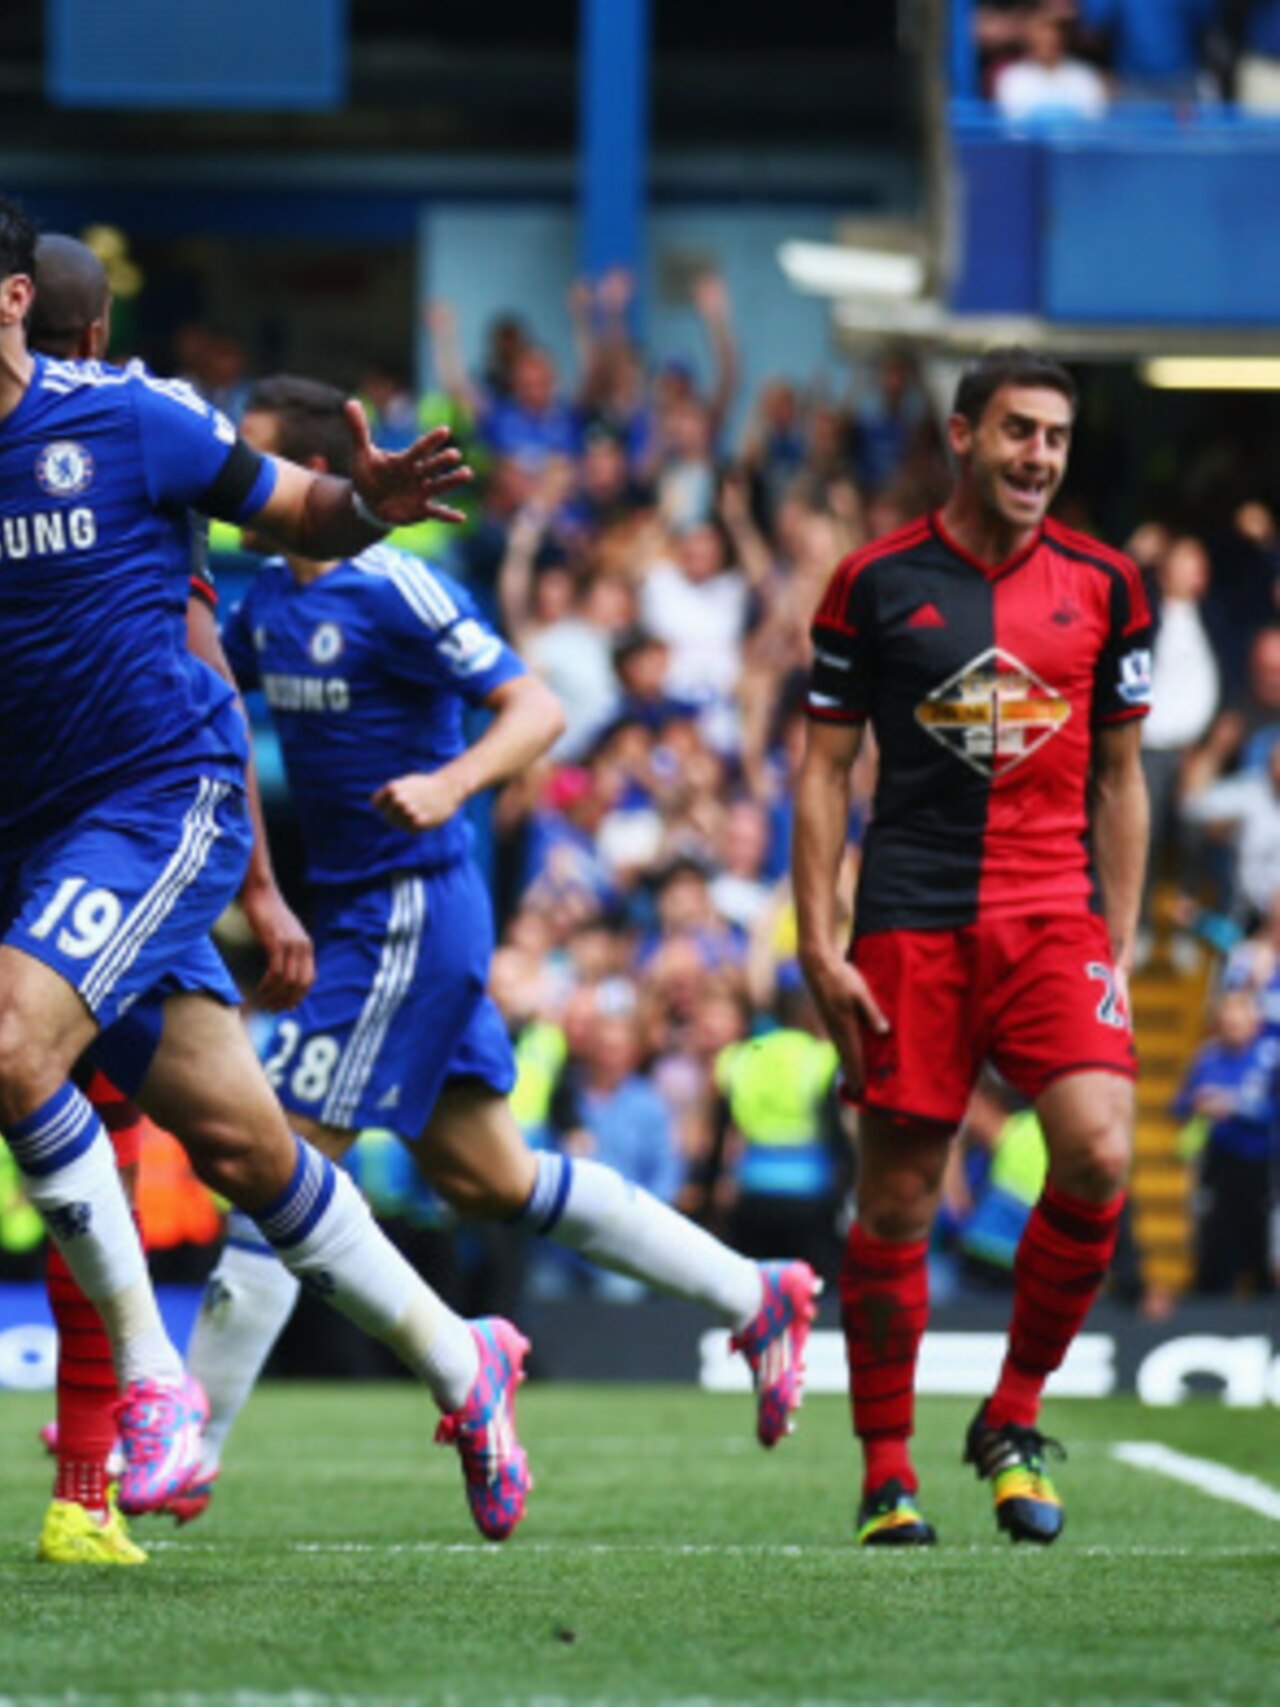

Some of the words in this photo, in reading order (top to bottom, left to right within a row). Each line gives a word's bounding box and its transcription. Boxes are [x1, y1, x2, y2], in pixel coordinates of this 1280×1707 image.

[28, 876, 123, 958] 19
[1083, 961, 1130, 1029] 2
[264, 1018, 340, 1102] 28
